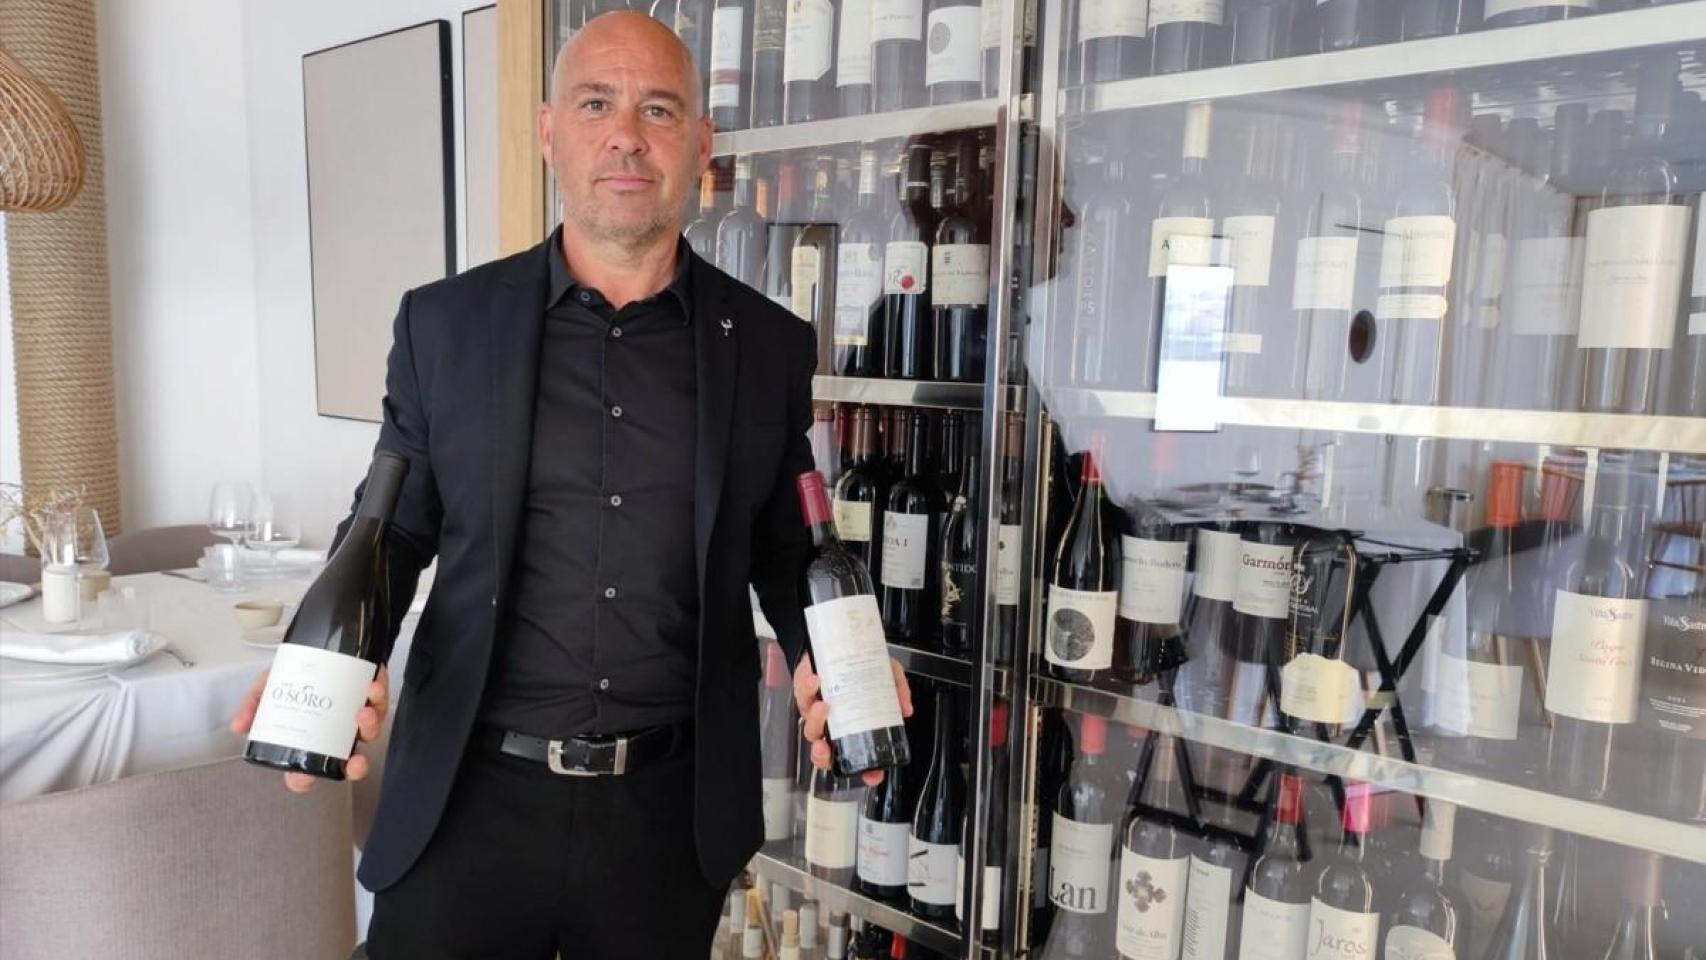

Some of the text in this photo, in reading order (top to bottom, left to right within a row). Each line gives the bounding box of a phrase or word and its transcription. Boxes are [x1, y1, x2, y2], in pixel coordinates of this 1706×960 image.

[1242, 553, 1294, 571] Garmón
[272, 687, 284, 701] O
[1309, 917, 1368, 956] Jaros
